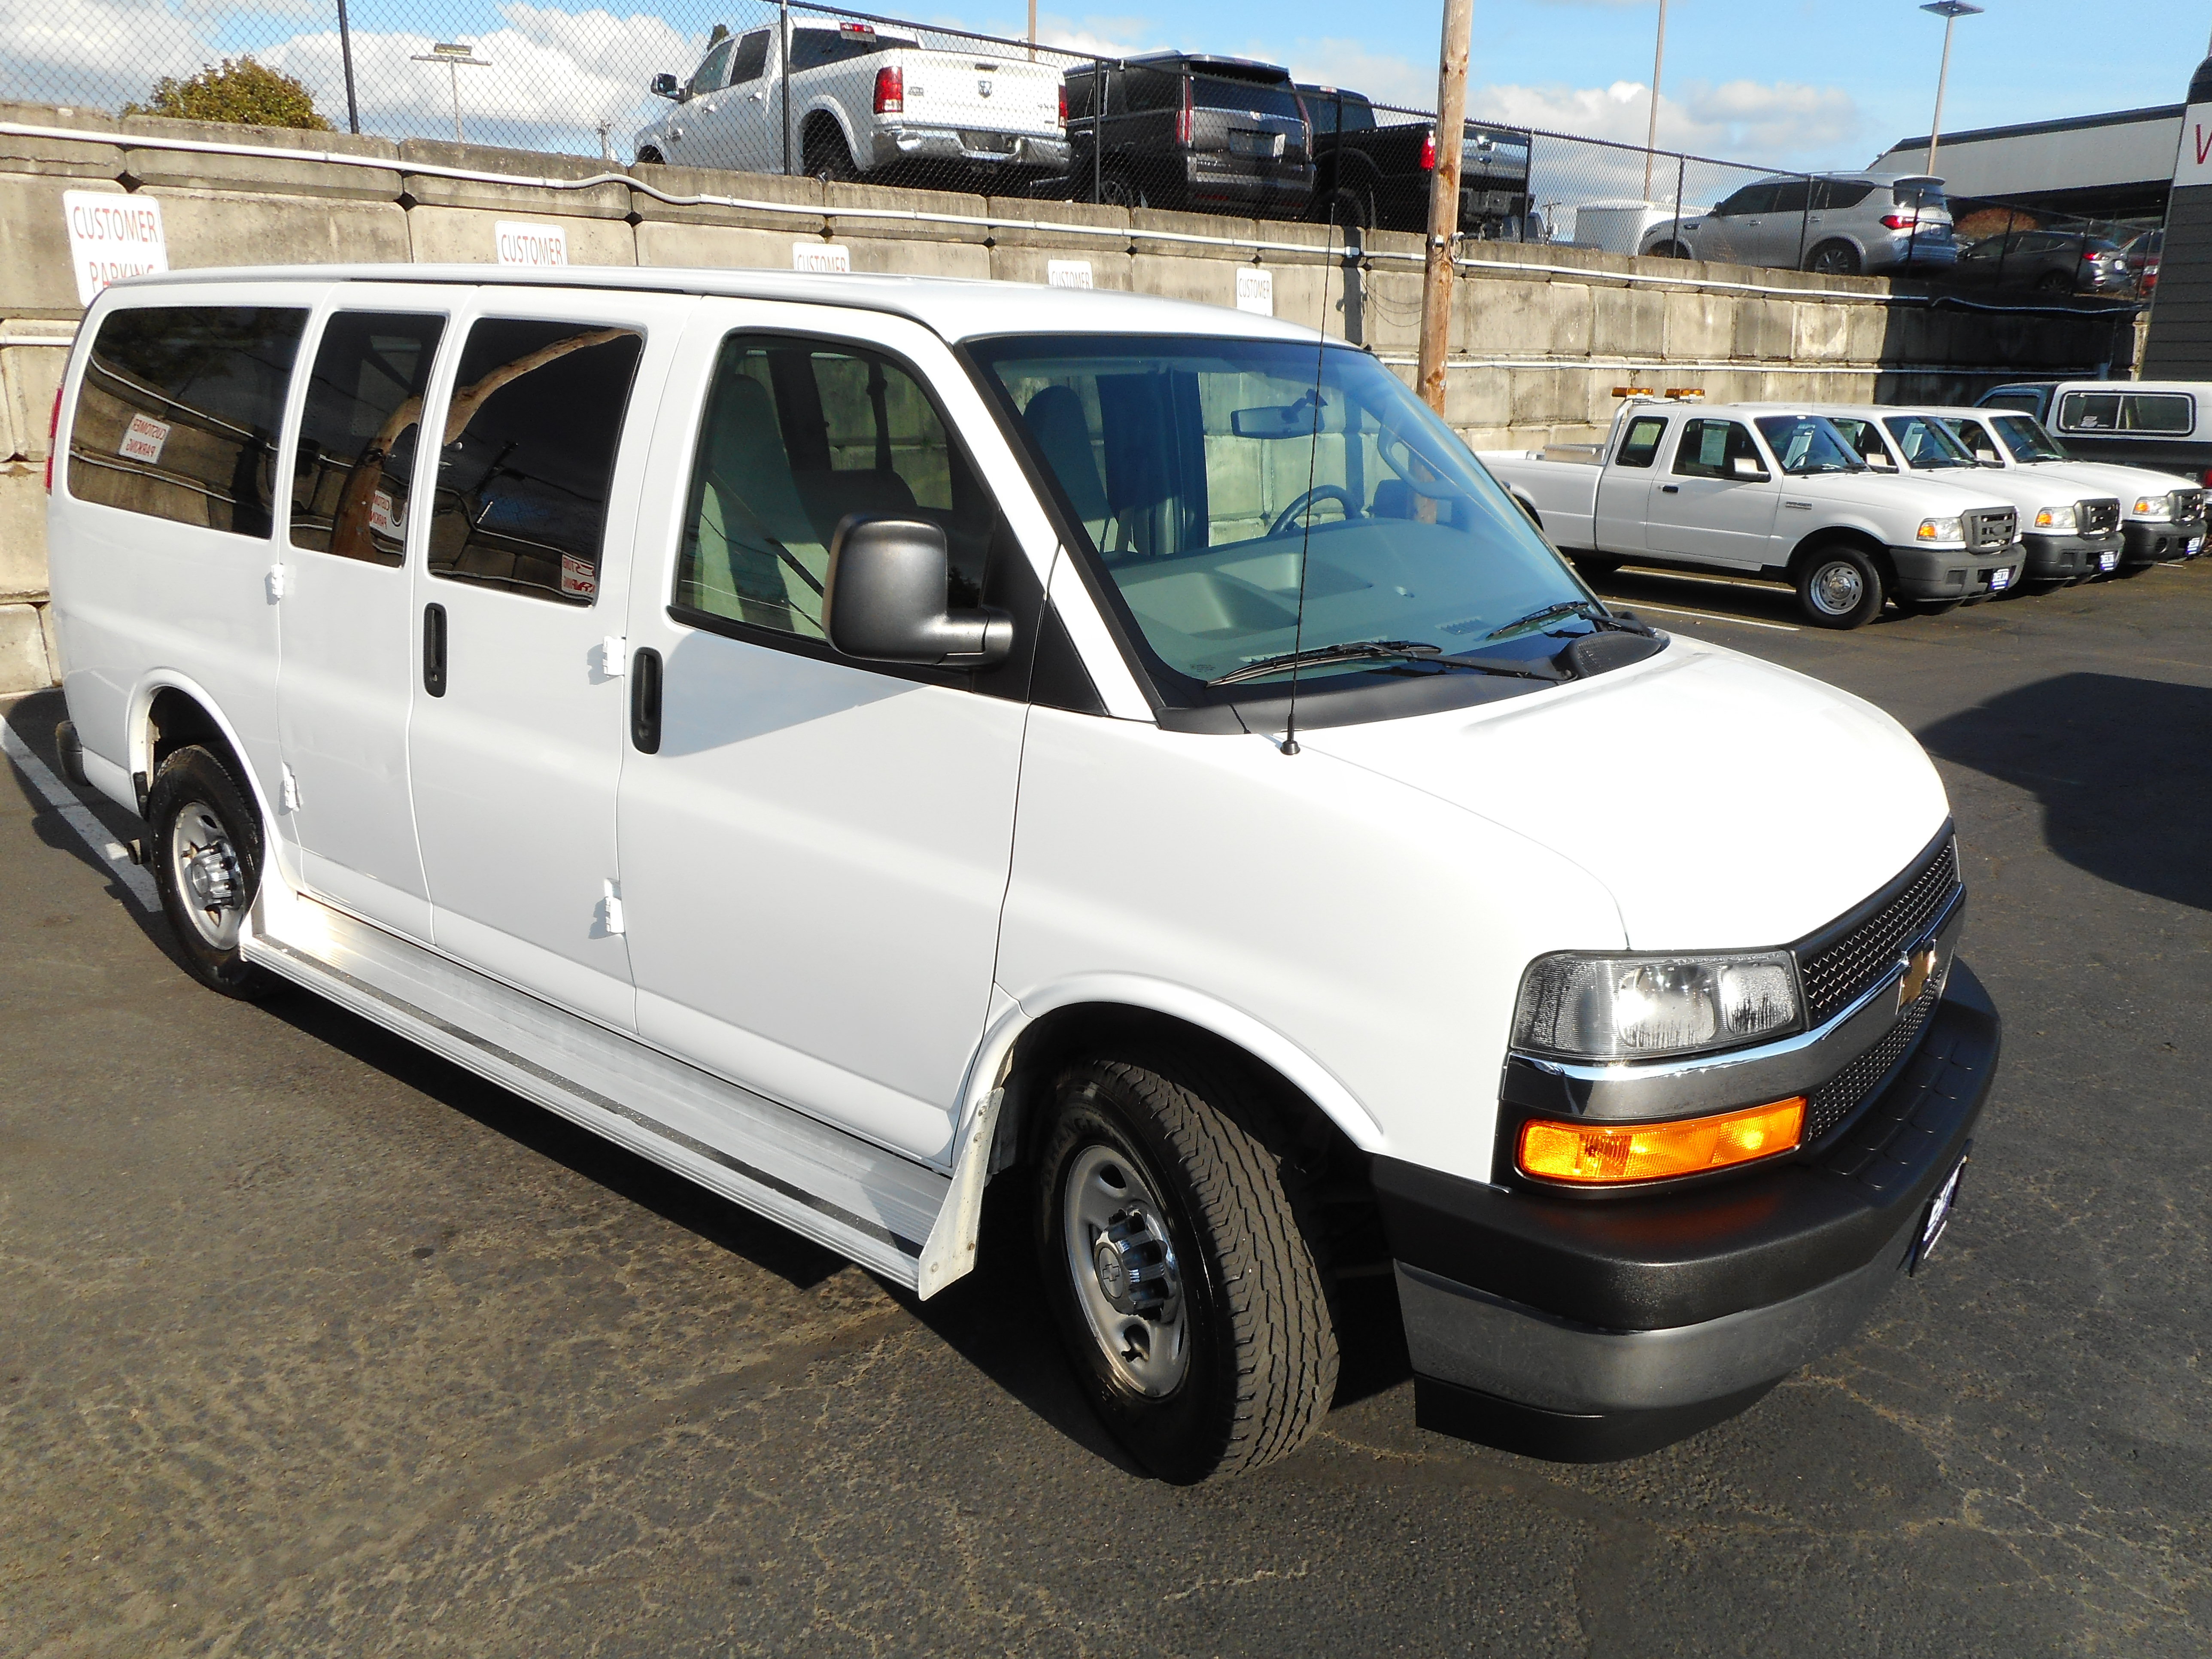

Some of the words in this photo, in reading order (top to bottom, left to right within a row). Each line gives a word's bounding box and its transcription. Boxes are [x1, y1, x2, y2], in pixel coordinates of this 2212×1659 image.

[73, 206, 158, 243] CUSTOMER
[501, 234, 563, 265] CUSTOMER
[797, 254, 846, 273] CUSTOMER
[1051, 270, 1091, 290] CUSTOMER
[1239, 278, 1270, 299] CUSTOMER
